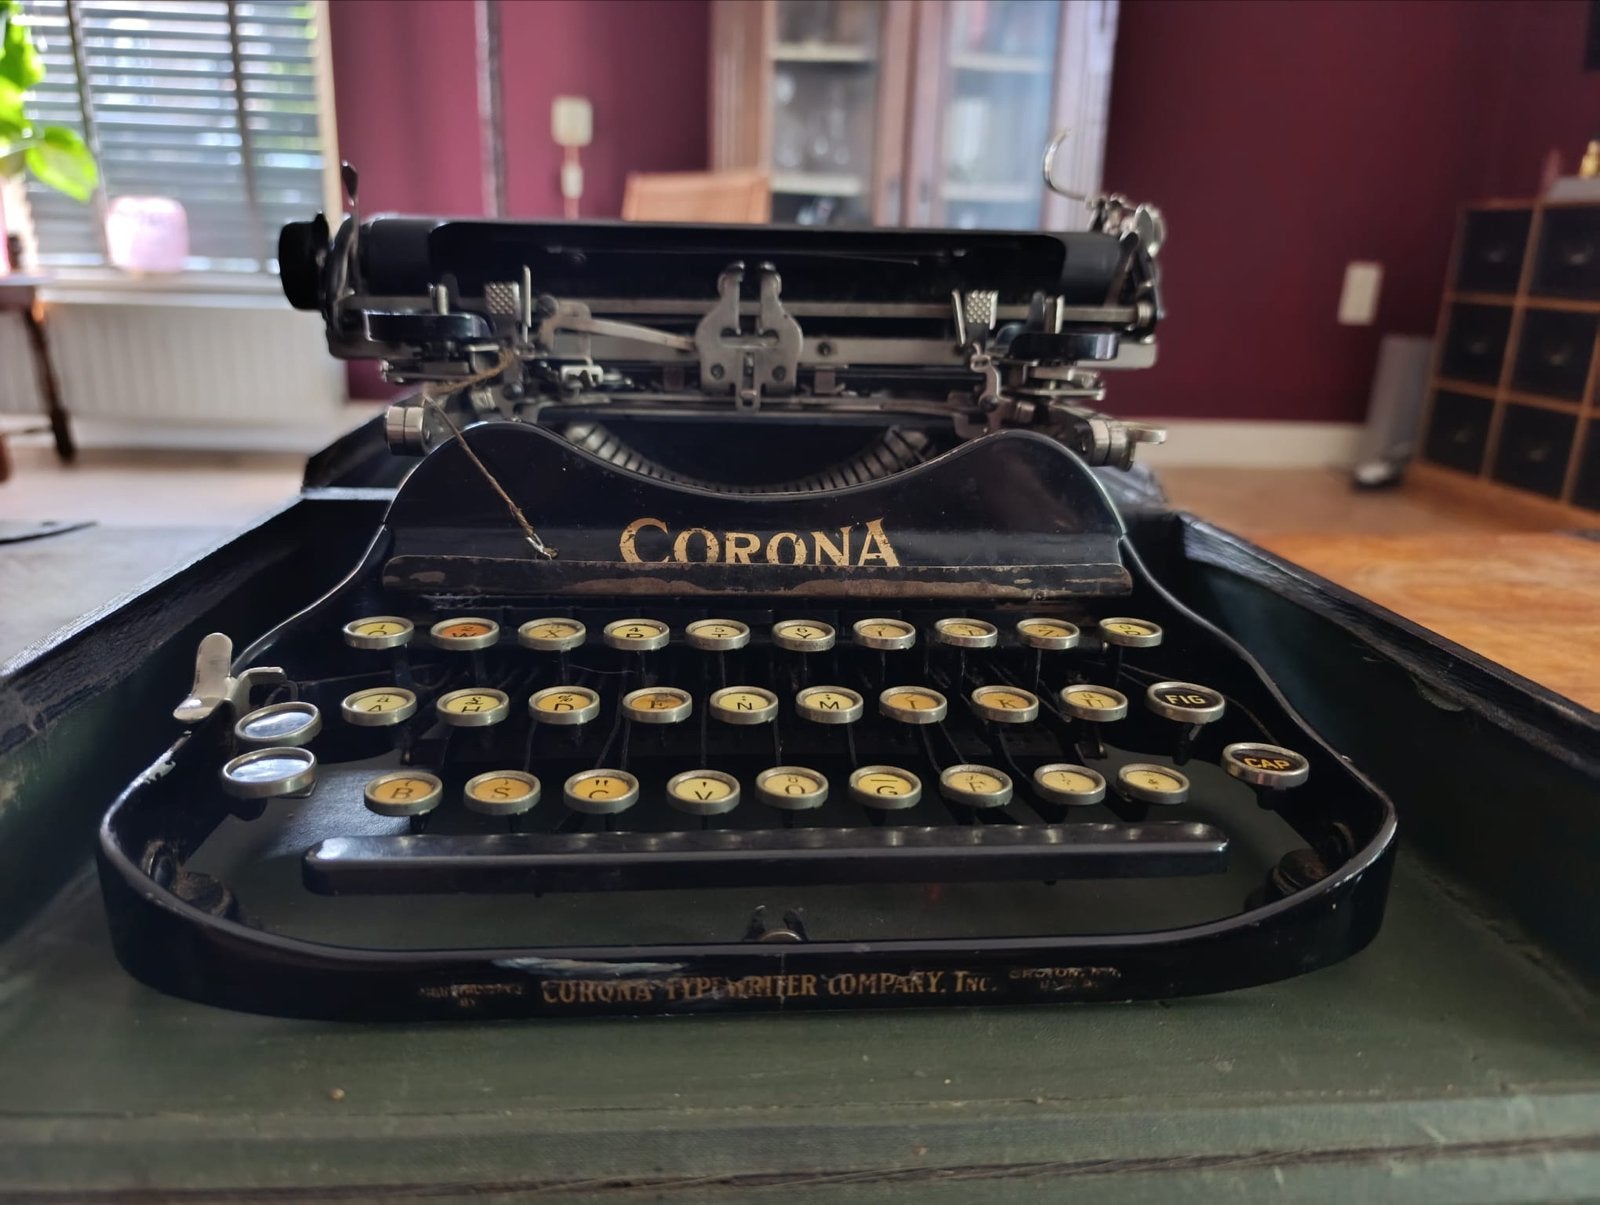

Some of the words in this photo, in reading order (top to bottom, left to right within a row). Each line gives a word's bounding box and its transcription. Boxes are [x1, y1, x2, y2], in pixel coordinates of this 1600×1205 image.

[619, 517, 900, 566] CORONA
[818, 701, 840, 710] M
[1164, 695, 1208, 705] FIG
[736, 702, 752, 710] N
[1244, 758, 1290, 770] CAP
[390, 788, 413, 799] B
[541, 979, 653, 1003] CORONA
